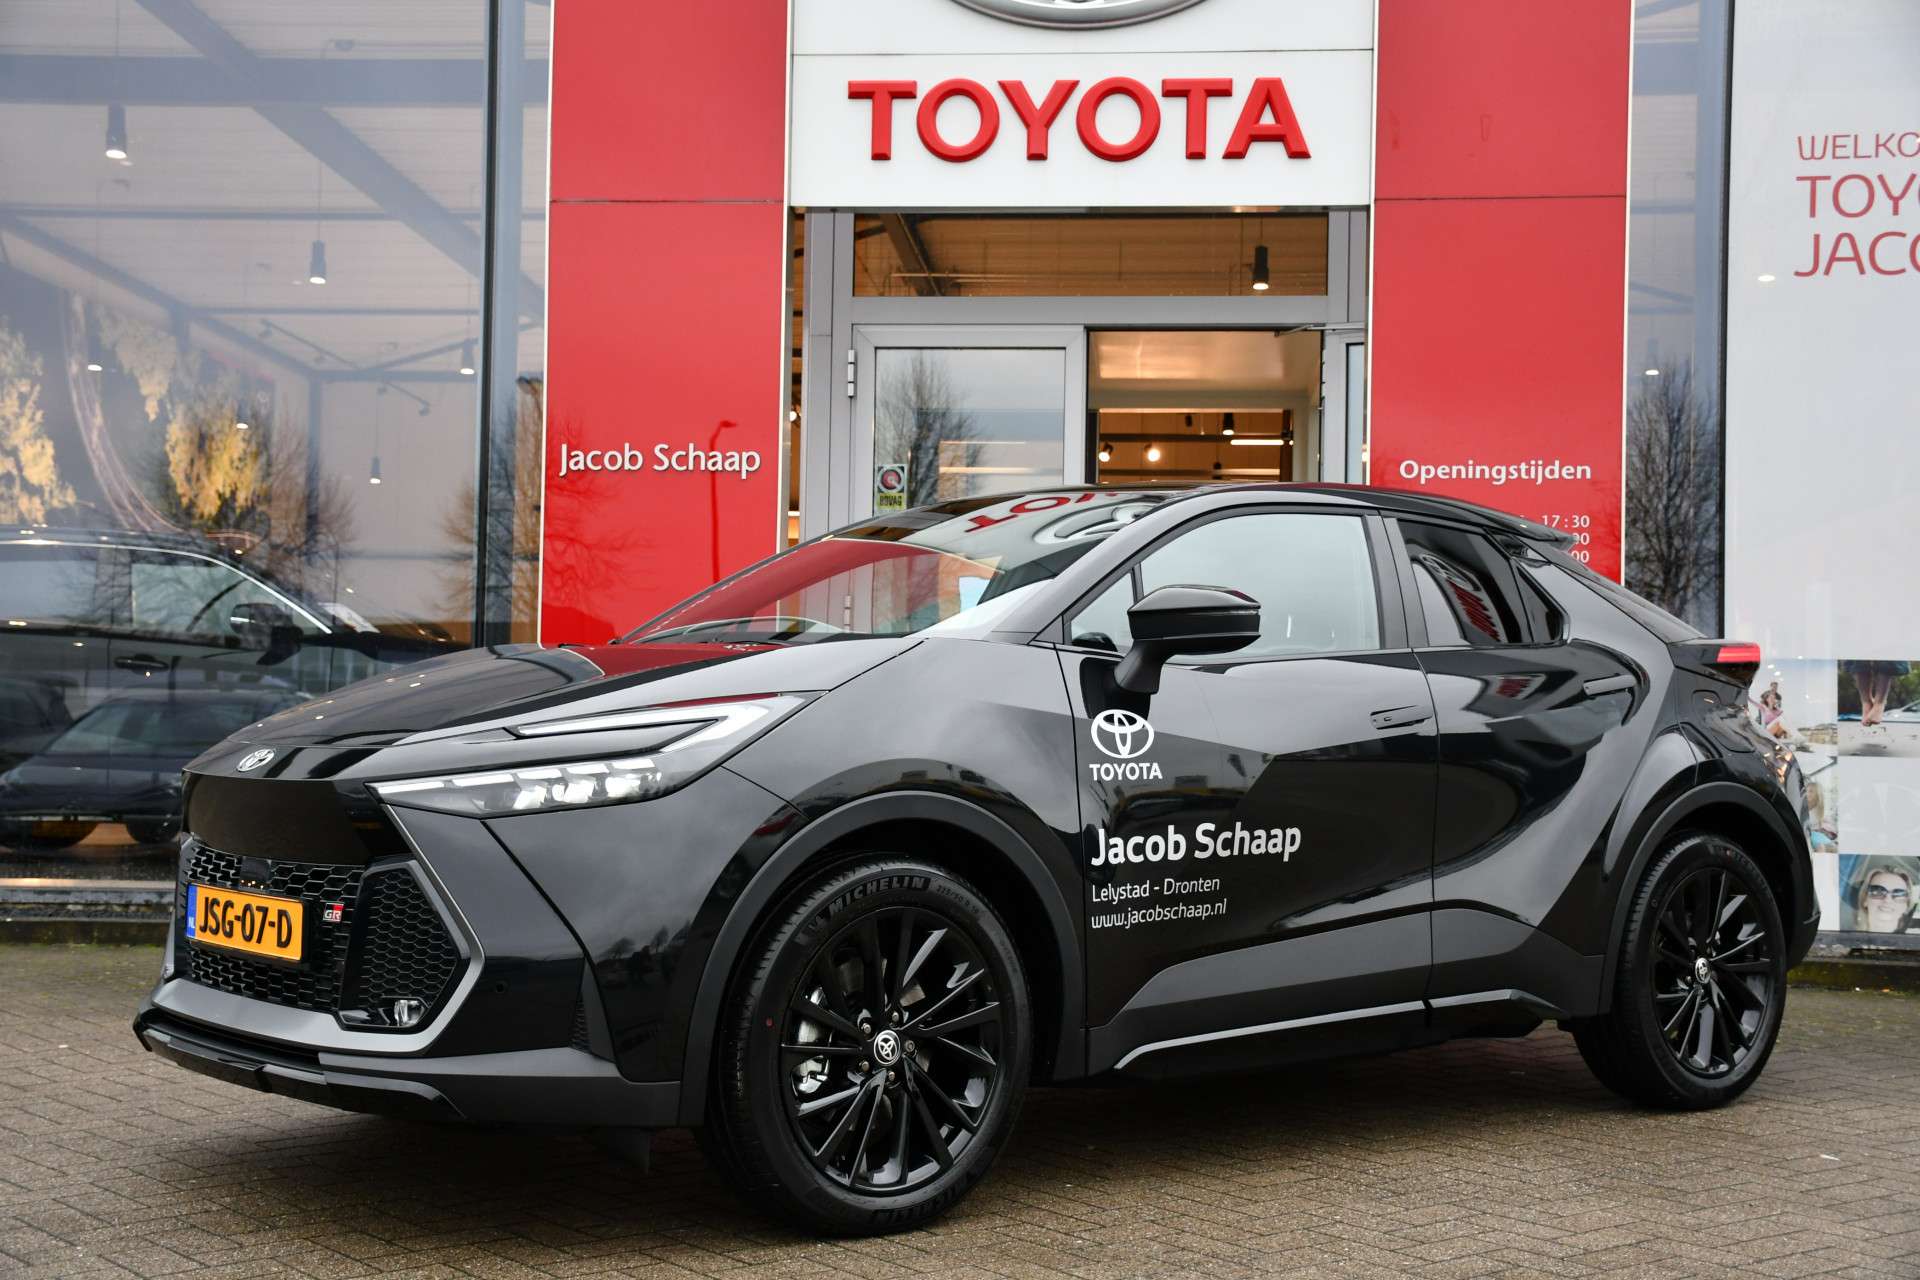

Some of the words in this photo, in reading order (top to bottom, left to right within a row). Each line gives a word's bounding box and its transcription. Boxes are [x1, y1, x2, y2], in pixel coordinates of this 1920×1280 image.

[848, 77, 1311, 162] TOYOTA
[1796, 173, 1920, 218] TOY
[1794, 231, 1920, 277] JAC
[559, 443, 643, 477] Jacob
[653, 443, 761, 479] Schaap
[1400, 460, 1592, 485] Openingstijden
[1089, 762, 1163, 781] TOYOTA
[1091, 824, 1187, 866] Jacob
[1194, 821, 1301, 862] Schaap
[829, 875, 926, 915] MICHELIN
[1092, 880, 1150, 904] Lelystad
[1163, 877, 1220, 895] Dronten
[200, 896, 292, 948] JSG-07-D
[324, 908, 341, 920] GR
[1091, 898, 1227, 929] www.jacobschaap.nl
